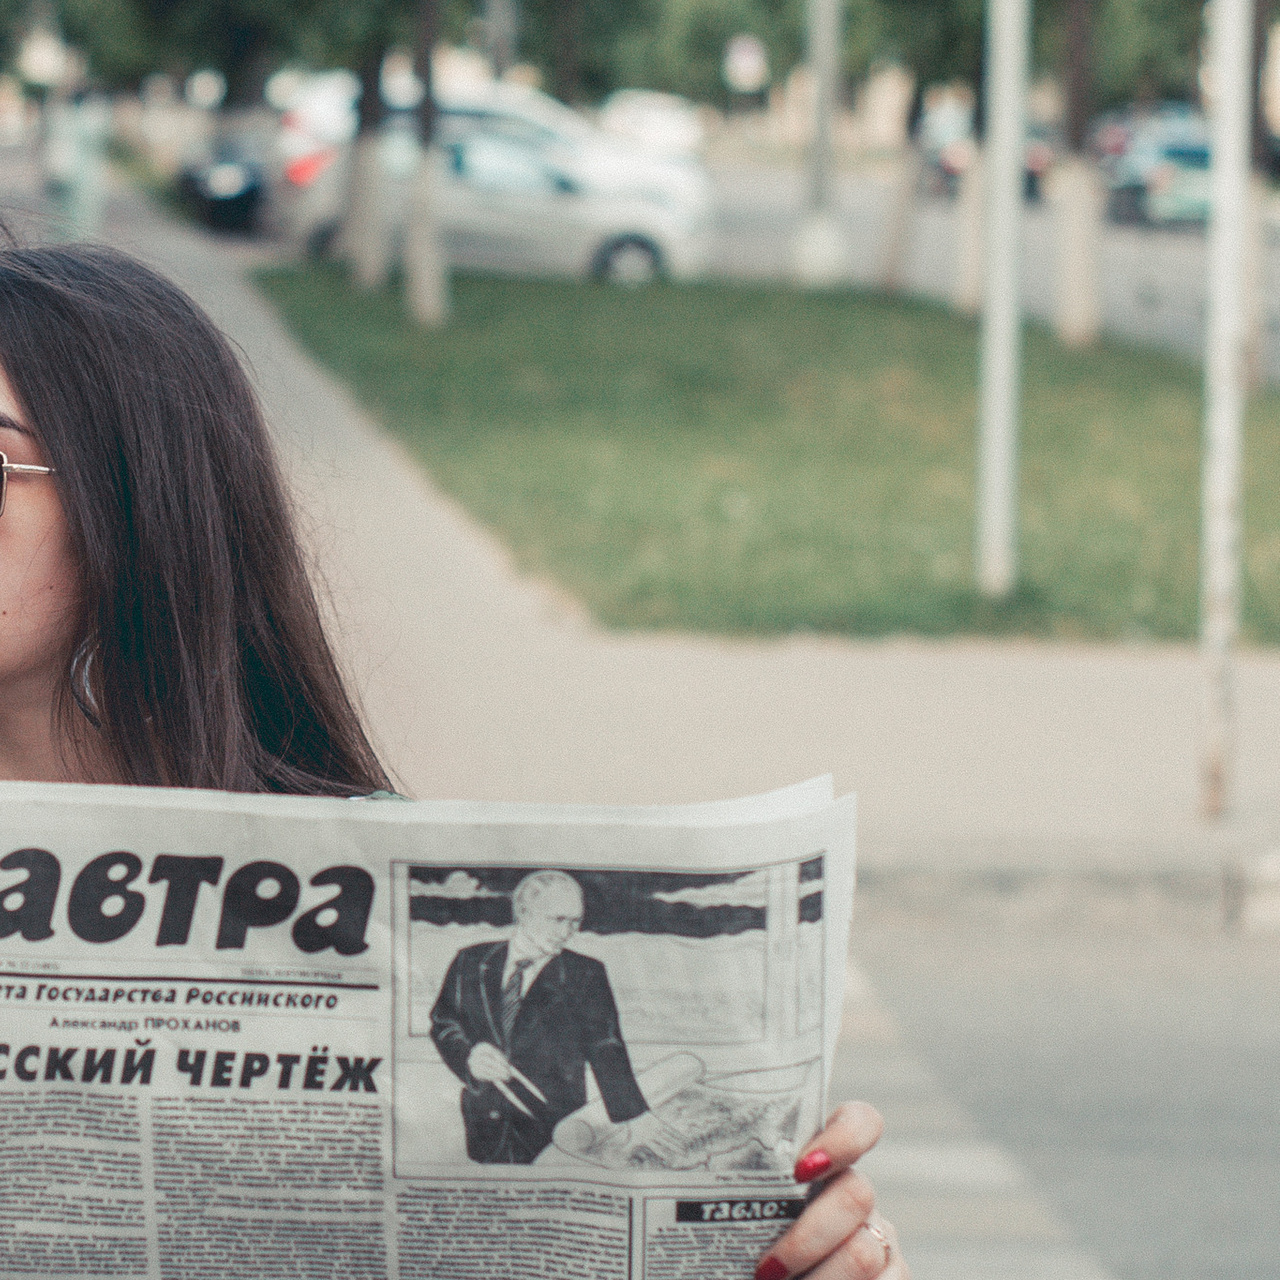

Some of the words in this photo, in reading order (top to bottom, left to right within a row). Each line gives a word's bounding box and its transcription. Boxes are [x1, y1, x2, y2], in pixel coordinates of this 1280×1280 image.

[36, 984, 176, 1003] Государства
[50, 1017, 138, 1031] Александр
[145, 1017, 241, 1032] ПРОХАНОВ
[177, 1045, 382, 1093] ЧЕРТЁЖ
